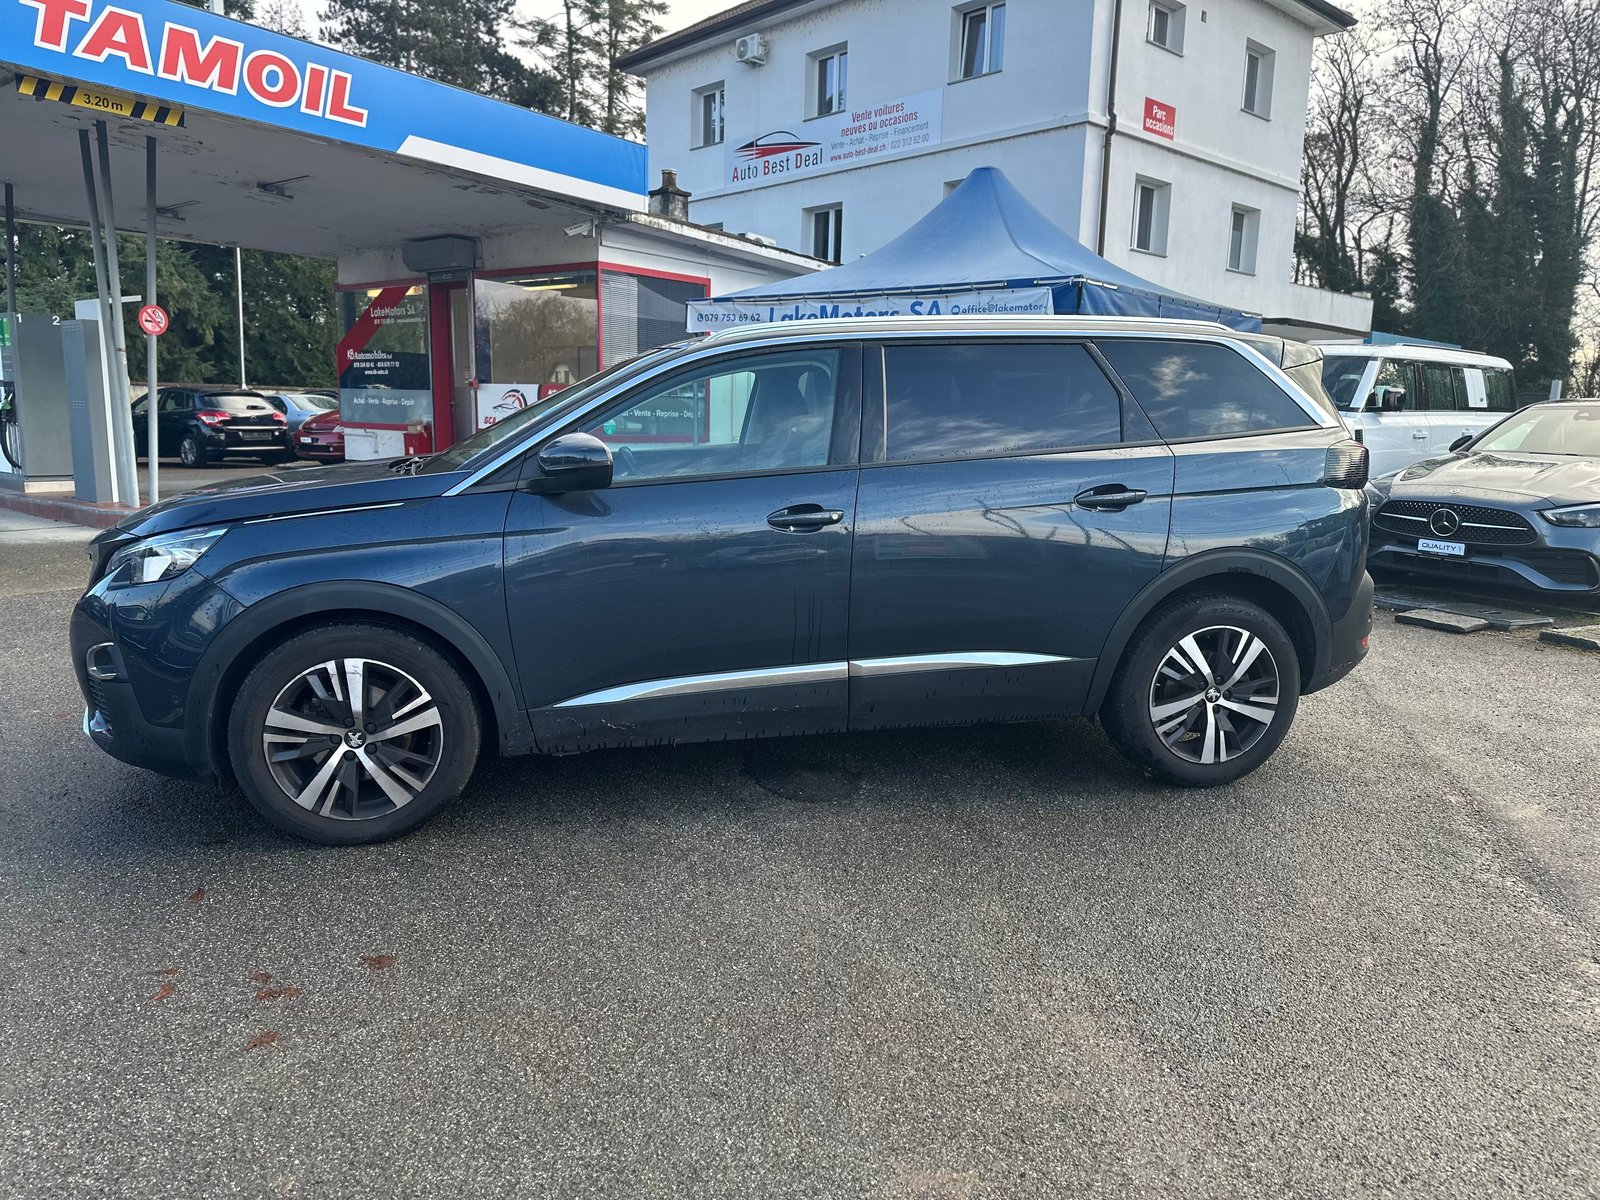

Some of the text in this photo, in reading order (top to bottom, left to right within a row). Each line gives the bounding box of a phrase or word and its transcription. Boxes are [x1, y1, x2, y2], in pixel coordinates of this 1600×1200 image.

[19, 0, 369, 129] TAMOIL
[83, 93, 123, 111] 3.20 m
[852, 102, 905, 123] Vente voitures
[1152, 105, 1167, 120] Parc
[840, 111, 918, 137] neuves ou occasions
[1145, 118, 1174, 135] occasions
[830, 141, 844, 150] Vente
[849, 136, 864, 147] Achat
[868, 132, 889, 142] Reprise
[893, 121, 929, 136] Financement
[830, 143, 886, 162] www.auto-best-deal.ch
[890, 140, 900, 149] 022
[901, 136, 912, 147] 312
[913, 135, 921, 145] 52
[921, 133, 930, 143] 00
[732, 148, 823, 182] Auto Best Deal
[370, 303, 416, 318] LakeMotors SA
[909, 300, 941, 315] SA
[961, 302, 1047, 314] office@lakemotor
[16, 313, 22, 323] 1
[52, 315, 61, 326] 2
[704, 312, 761, 322] 079 753 69 62
[633, 409, 651, 417] Vente
[656, 409, 679, 418] Reprise
[1421, 542, 1457, 551] QUALITY
